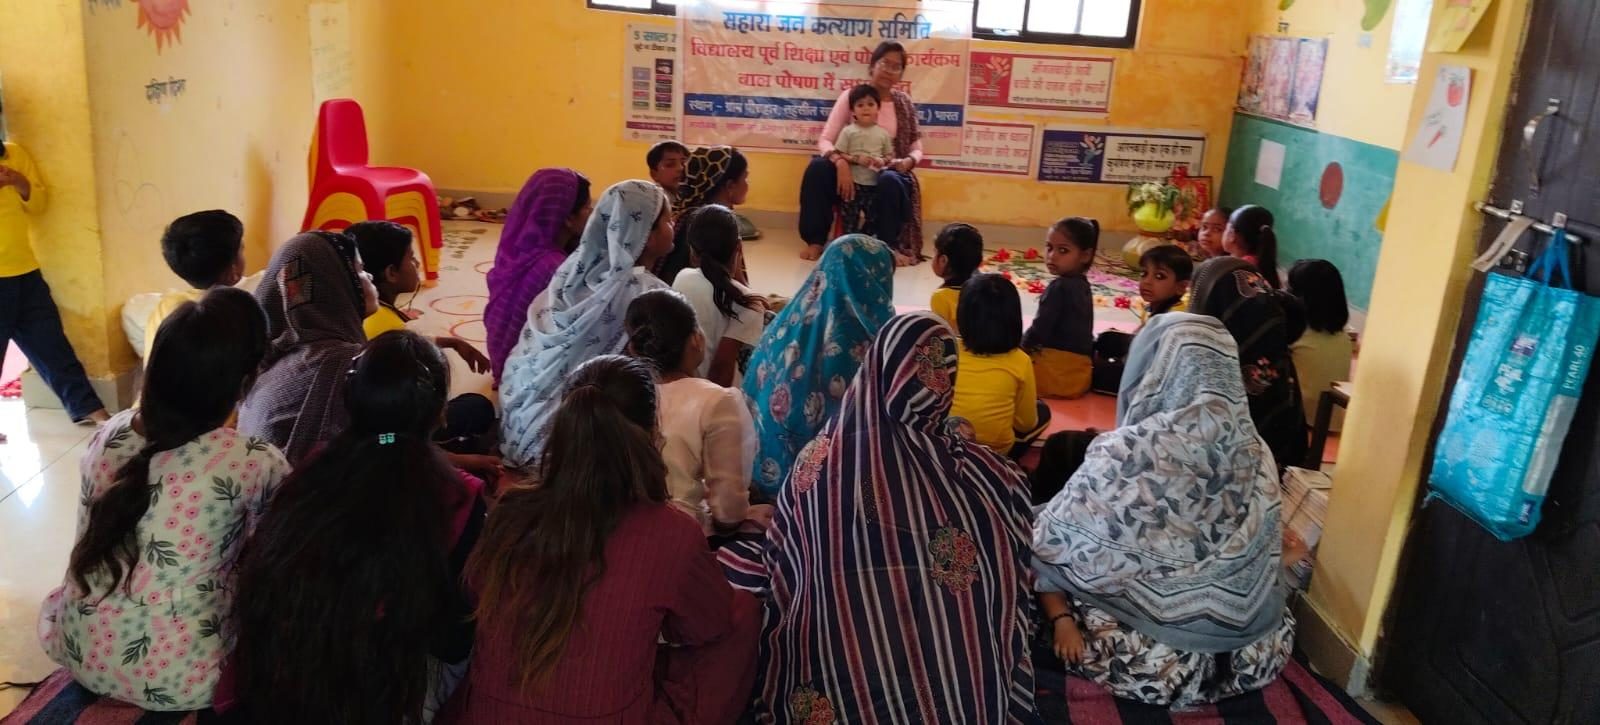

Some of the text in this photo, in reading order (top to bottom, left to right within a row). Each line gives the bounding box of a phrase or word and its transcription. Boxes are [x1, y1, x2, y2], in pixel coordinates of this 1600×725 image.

[723, 11, 931, 39] सहारा जन कल्याण समिति
[691, 37, 754, 58] विद्यालय
[758, 42, 780, 65] पूर्व
[784, 42, 824, 64] शिक्षा
[830, 46, 850, 67] एवं
[738, 73, 771, 87] बाल
[776, 70, 819, 89] पोषण
[823, 72, 836, 90] में
[688, 100, 713, 112] स्थान
[934, 110, 960, 121] भारत
[1562, 359, 1583, 390] PEARL
